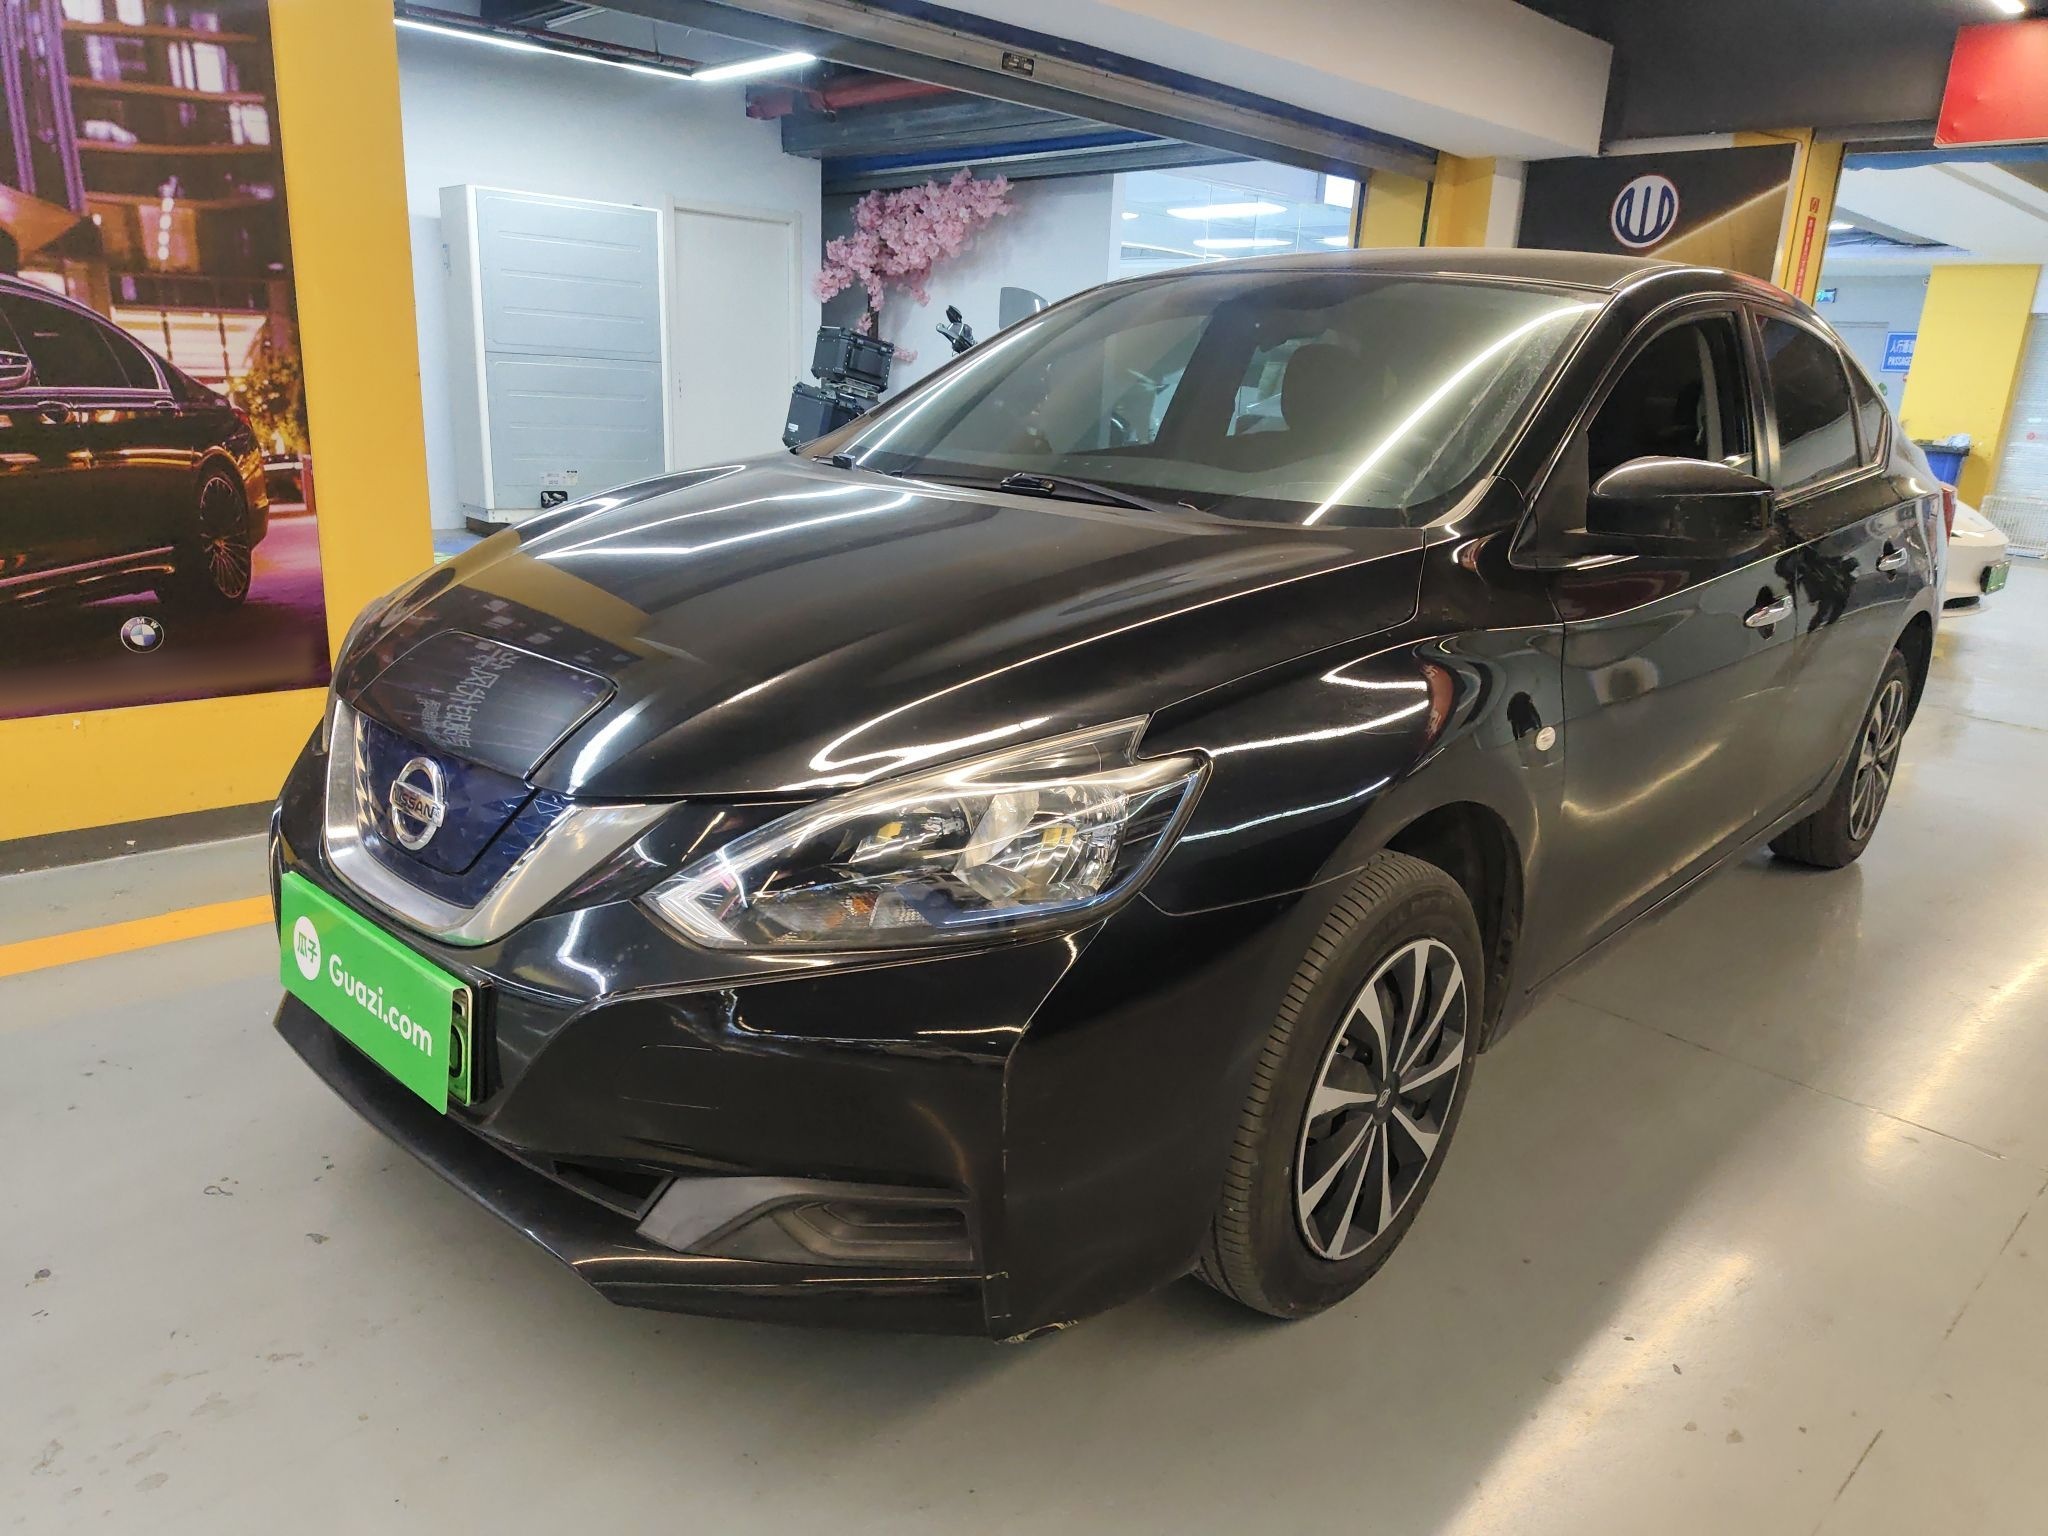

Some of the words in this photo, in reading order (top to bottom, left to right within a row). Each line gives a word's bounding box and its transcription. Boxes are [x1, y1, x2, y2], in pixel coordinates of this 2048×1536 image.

[393, 785, 435, 819] NISSAN
[297, 932, 318, 963] 瓜子
[329, 954, 433, 1056] Guazi.com
